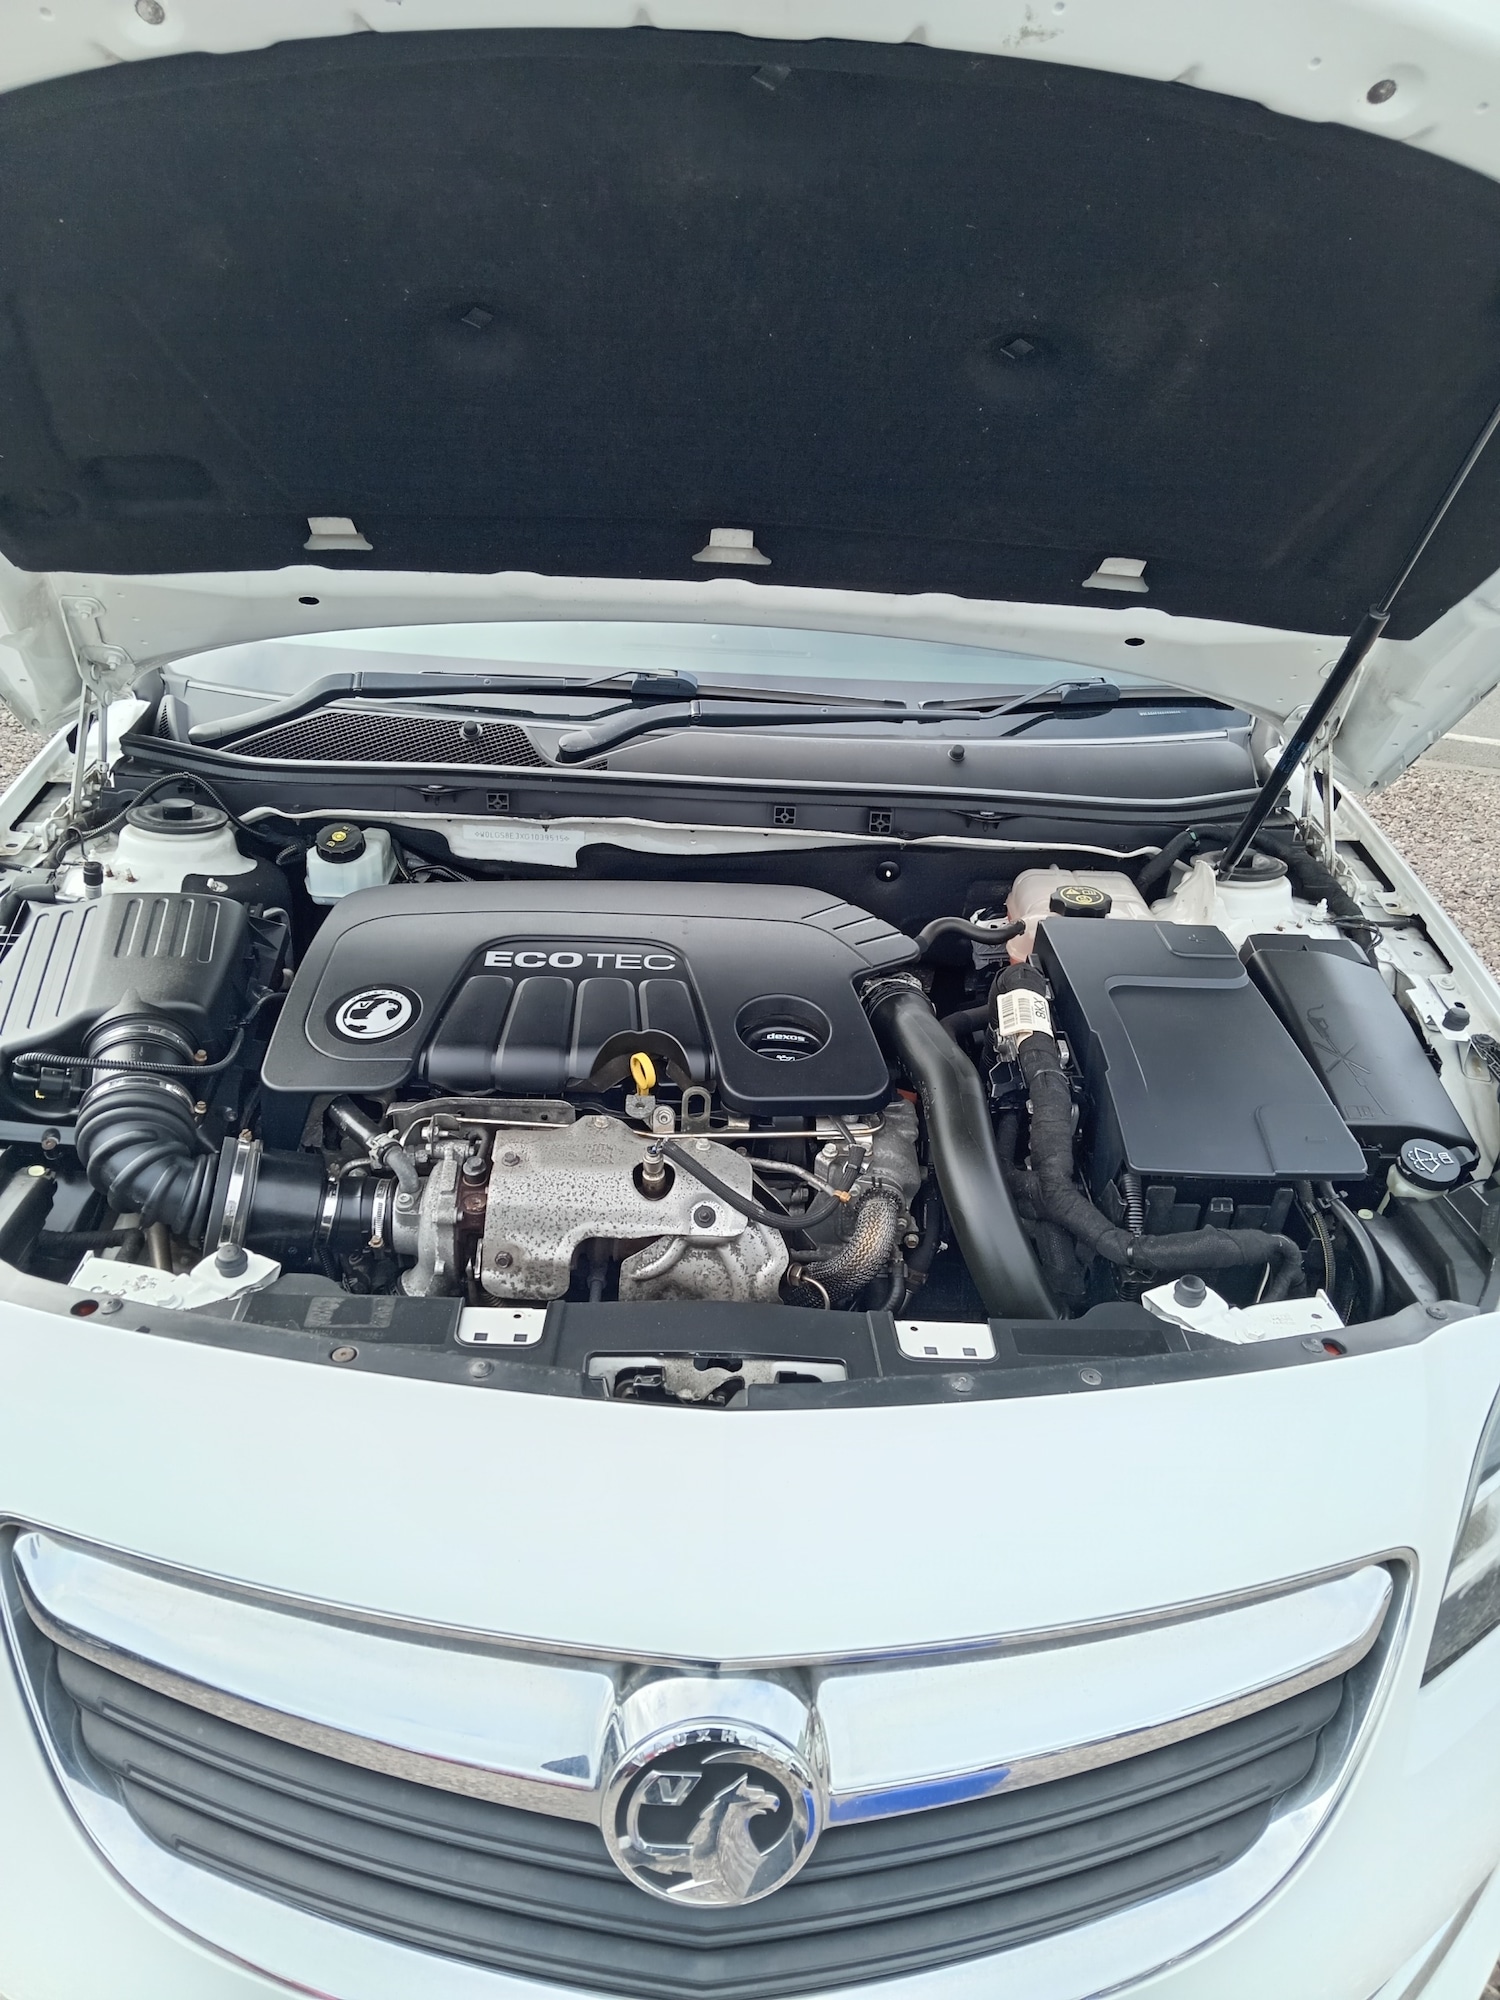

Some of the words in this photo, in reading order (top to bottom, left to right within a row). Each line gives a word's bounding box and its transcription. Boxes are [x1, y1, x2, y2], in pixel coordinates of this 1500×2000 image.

[484, 951, 677, 970] ECOTEC
[766, 1033, 806, 1042] dexos
[631, 1729, 796, 1771] VAUXHALL
